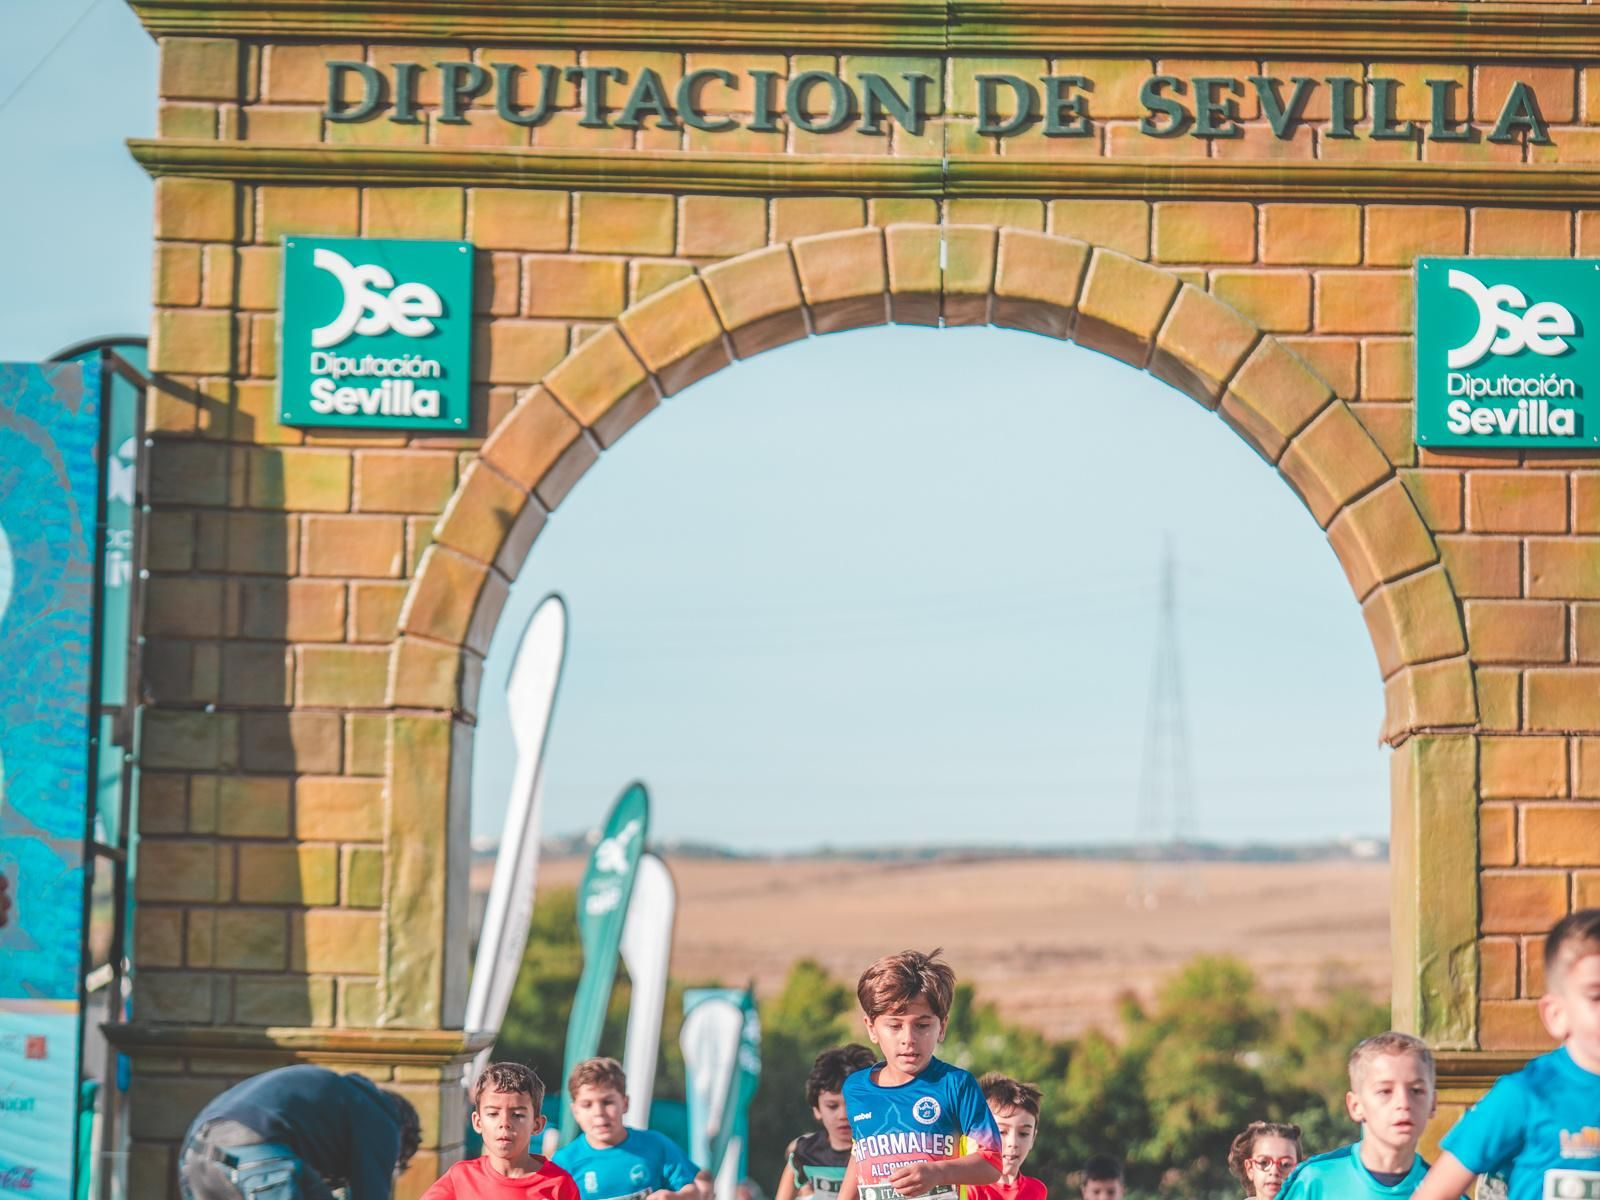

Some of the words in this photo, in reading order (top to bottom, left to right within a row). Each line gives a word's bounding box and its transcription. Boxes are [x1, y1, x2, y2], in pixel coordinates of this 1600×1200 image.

[323, 61, 932, 136] DIPUTACION
[975, 74, 1092, 137] DE
[1140, 76, 1549, 144] SEVILLA
[310, 352, 441, 379] Diputación
[309, 377, 440, 417] Sevilla
[1447, 373, 1575, 400] Diputación
[1447, 399, 1575, 436] Sevilla
